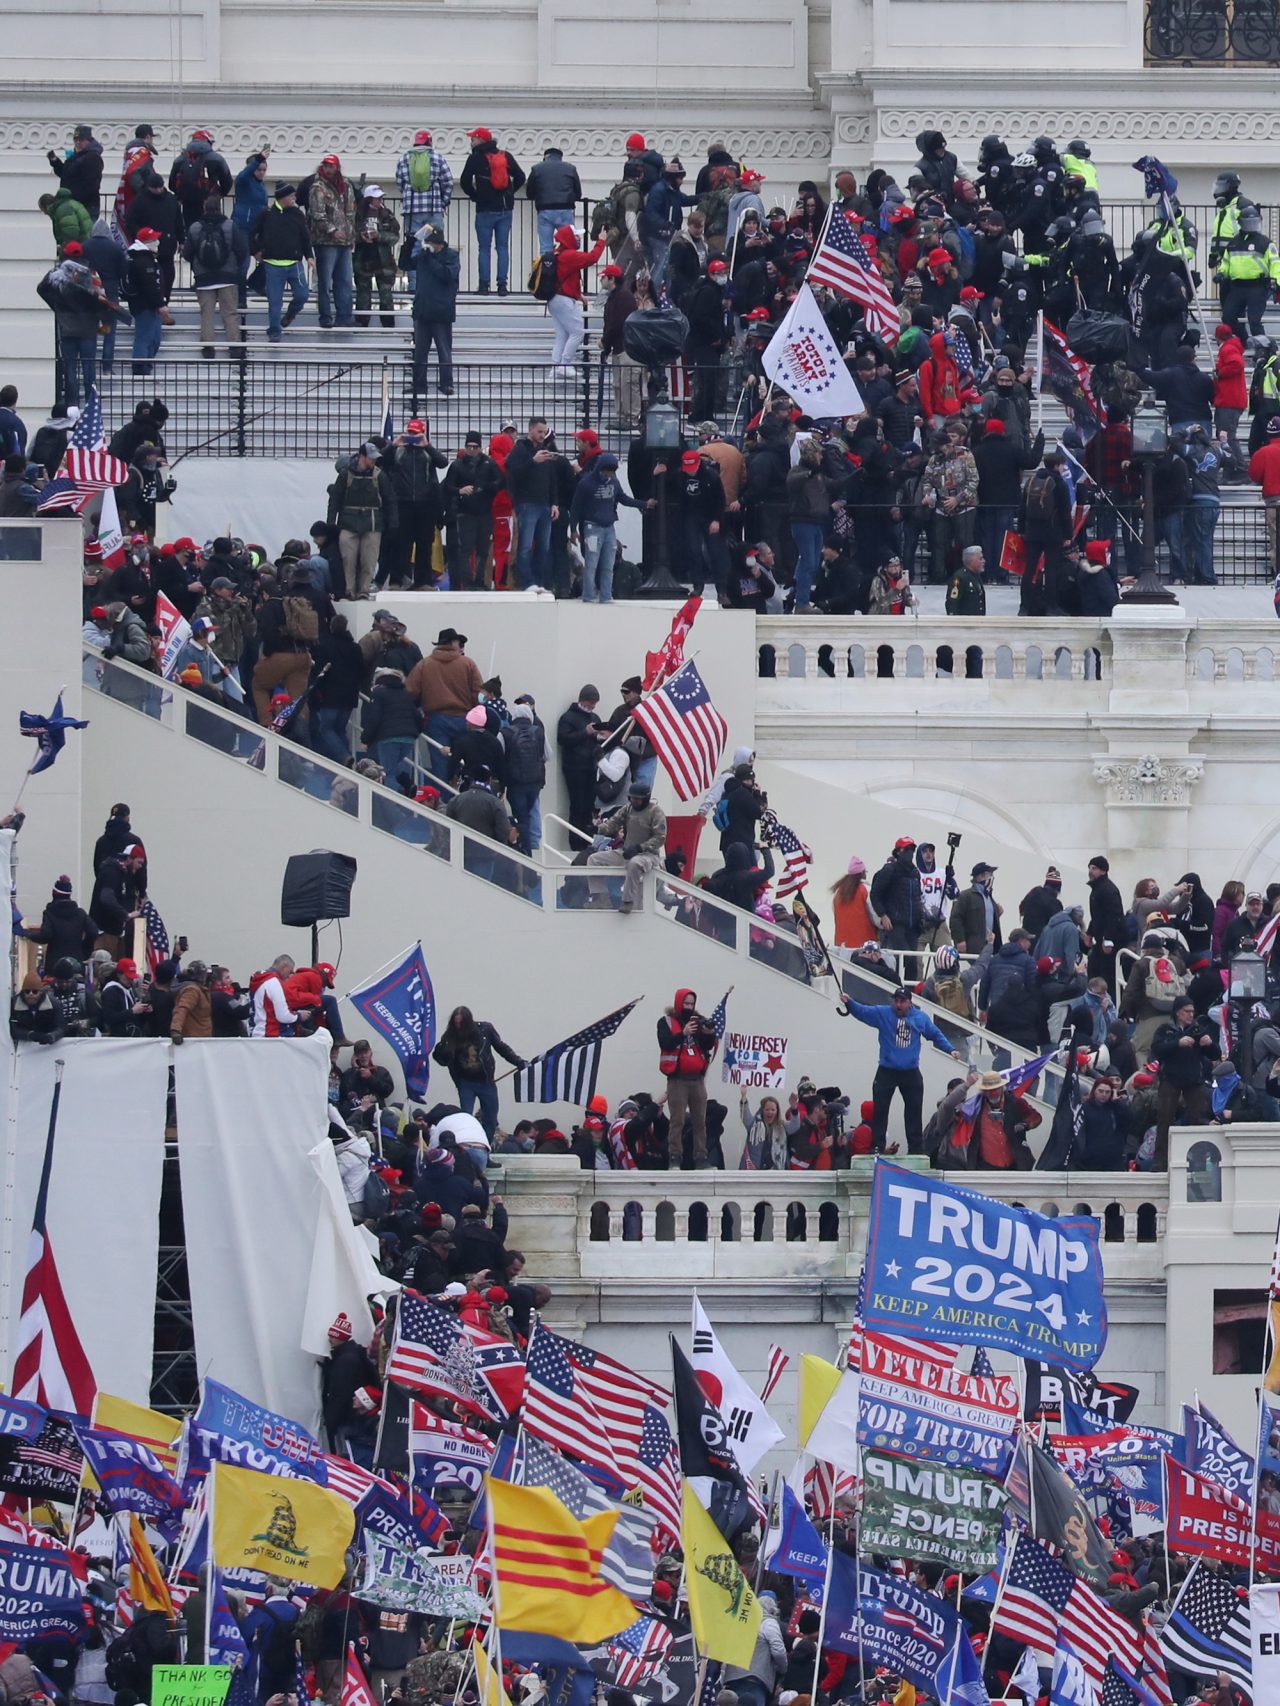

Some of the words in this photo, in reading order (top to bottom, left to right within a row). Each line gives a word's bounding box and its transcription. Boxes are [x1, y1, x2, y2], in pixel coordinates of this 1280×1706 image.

[791, 343, 819, 381] ARMY
[373, 1001, 401, 1030] KEEPING
[397, 1026, 418, 1055] AMERIC
[730, 1033, 746, 1050] NEW
[746, 1035, 788, 1054] JERSEY
[738, 1050, 760, 1061] FOR
[730, 1070, 741, 1085] NO
[746, 1071, 770, 1088] JOE
[888, 1184, 1089, 1284] TRUMP
[911, 1257, 1068, 1330] 2024
[873, 1293, 929, 1317] KEEP
[932, 1305, 1021, 1333] AMERICA
[1026, 1321, 1098, 1359] TRUMP!
[863, 1337, 1019, 1409] VETERANS
[860, 1377, 898, 1398] KEEP
[902, 1390, 962, 1418] AMERICA
[967, 1410, 1012, 1432] GREAT!
[1082, 1411, 1104, 1428] ALL
[859, 1400, 907, 1434] FOR
[915, 1416, 1004, 1459] TRUMP
[82, 1436, 164, 1473] TRU
[443, 1440, 457, 1452] NO
[1107, 1454, 1132, 1463] United
[433, 1461, 482, 1492] 20
[1200, 1453, 1239, 1491] 2020
[1180, 1470, 1252, 1515] TRU
[1223, 1509, 1238, 1523] IS
[284, 1557, 298, 1566] ON
[298, 1559, 310, 1570] ME
[789, 1550, 818, 1568] KEEP
[1086, 1573, 1099, 1583] ME
[747, 1592, 753, 1607] ON
[858, 1571, 945, 1640] Trump
[40, 1617, 79, 1635] GREAT!
[739, 1609, 748, 1624] ME
[840, 1631, 880, 1650] KEEPING
[906, 1658, 936, 1681] GREAT!
[850, 1614, 901, 1647] Pence
[901, 1635, 938, 1667] 2020
[159, 1670, 207, 1682] THANK
